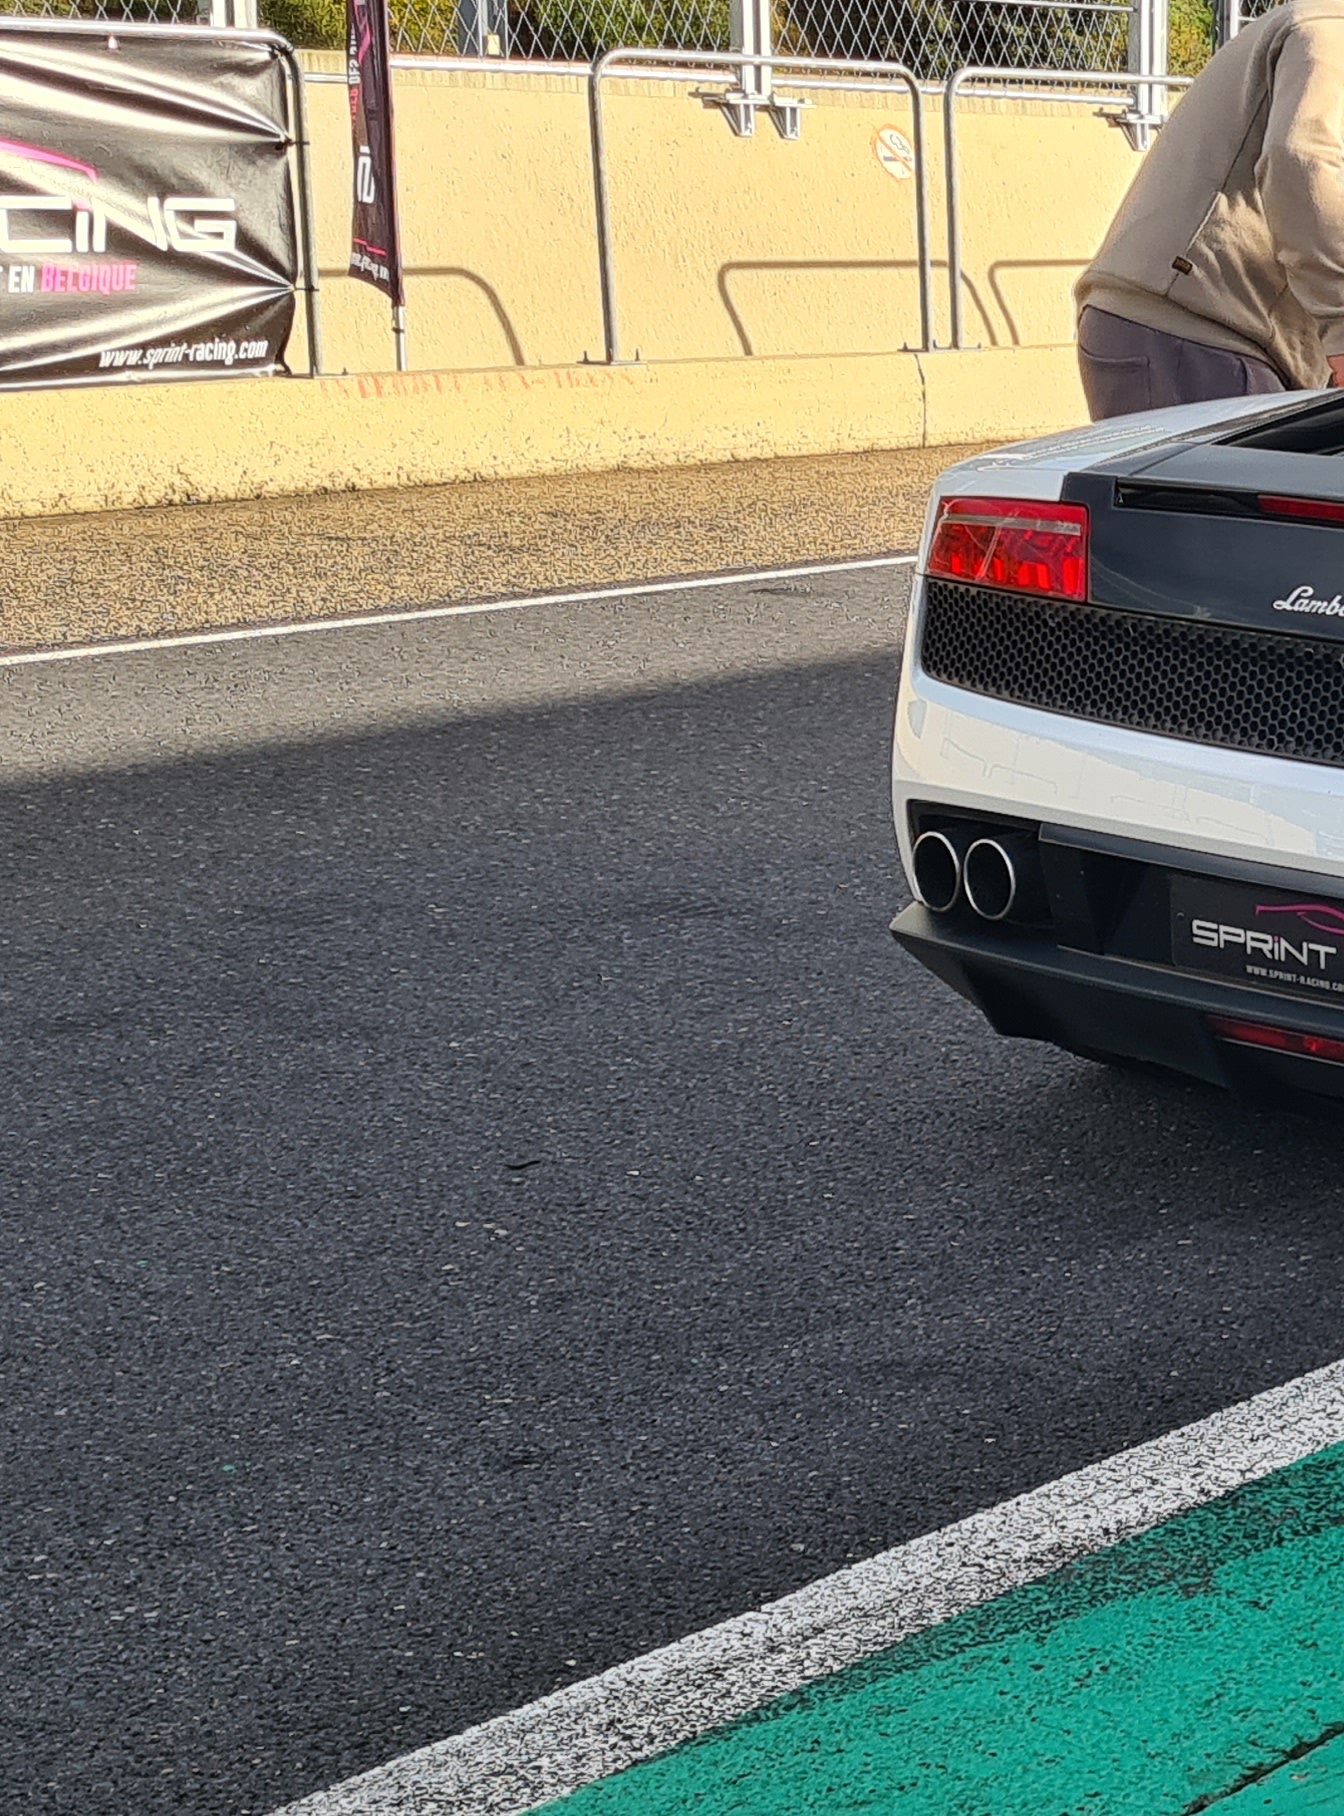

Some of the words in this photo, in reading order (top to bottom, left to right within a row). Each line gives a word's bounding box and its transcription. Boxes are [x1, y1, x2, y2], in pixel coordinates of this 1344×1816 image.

[8, 265, 35, 293] EN
[41, 262, 137, 295] BELGIQUE
[98, 337, 269, 369] www.sprint-racing.com
